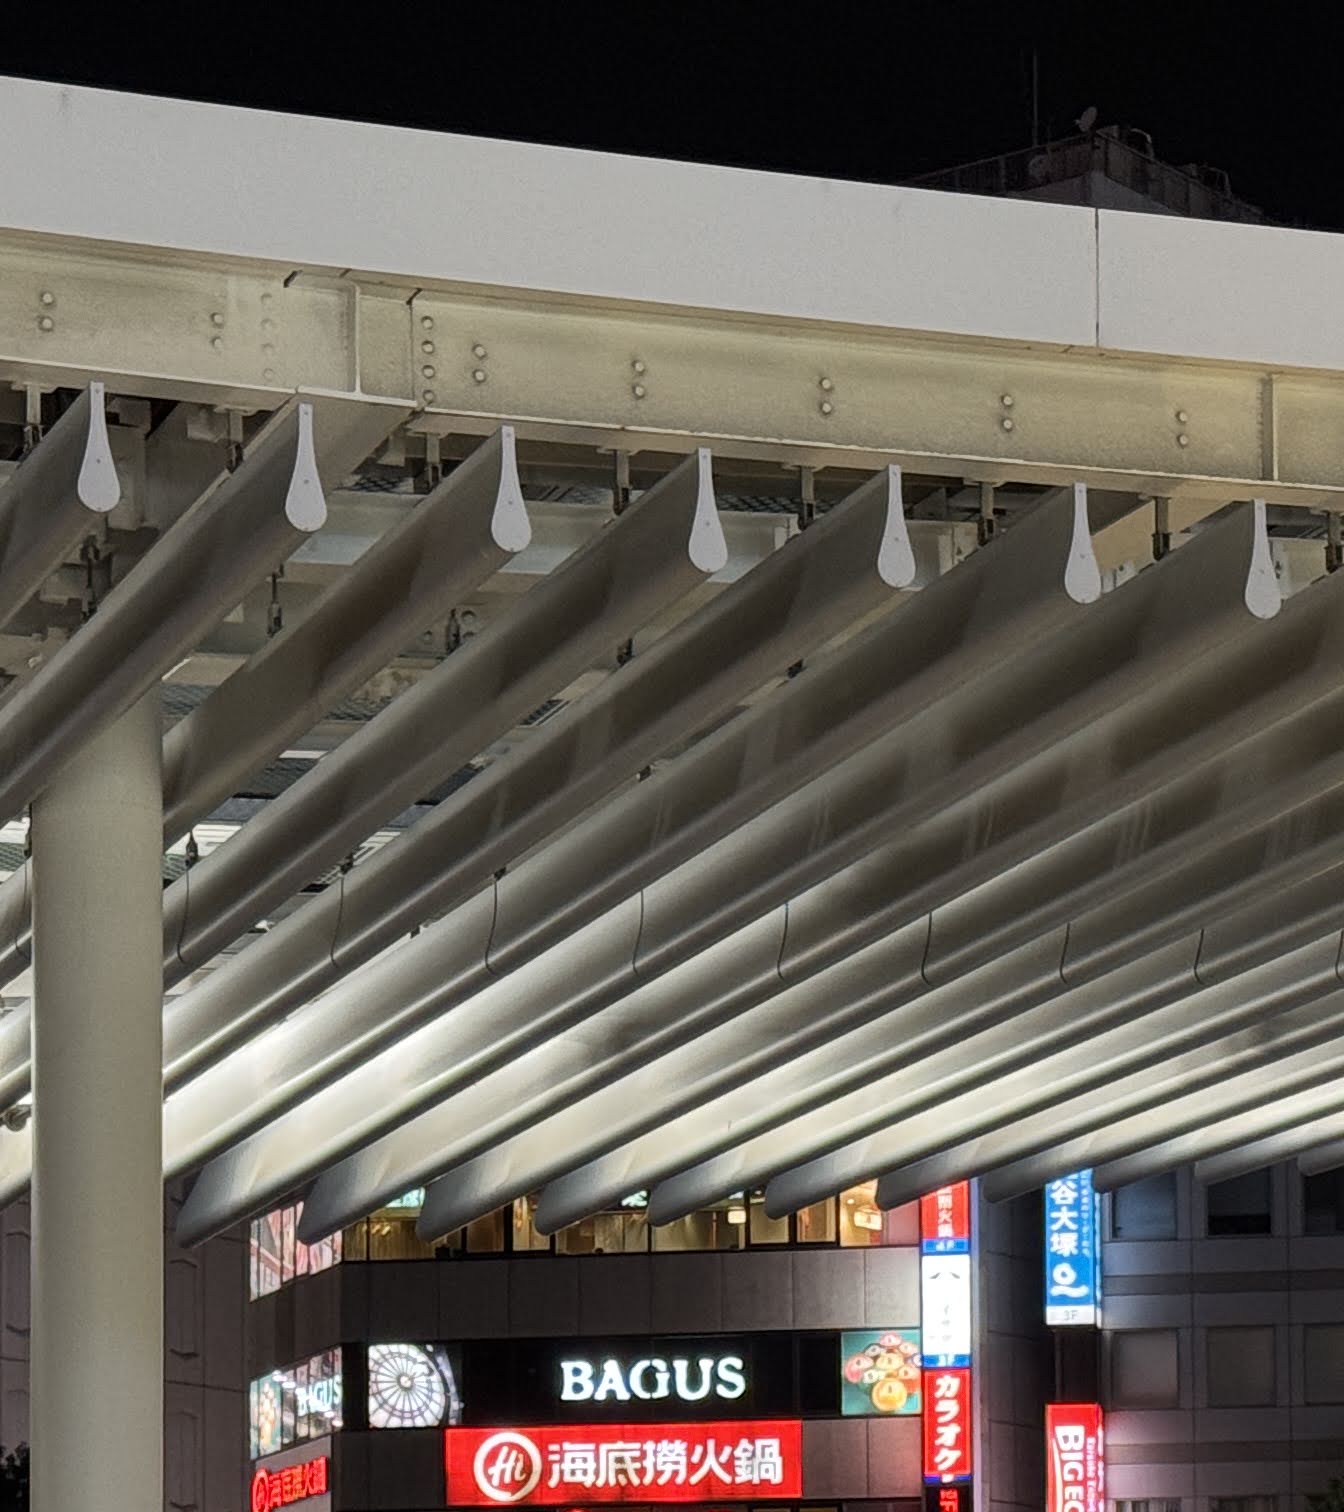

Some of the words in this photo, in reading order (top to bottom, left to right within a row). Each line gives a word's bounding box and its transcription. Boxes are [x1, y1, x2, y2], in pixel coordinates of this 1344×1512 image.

[1050, 1175, 1078, 1257] 谷大塚
[560, 1356, 746, 1401] BAGUS
[934, 1375, 961, 1471] カラオケ
[547, 1438, 783, 1488] 海底撈火鍋
[1055, 1425, 1086, 1481] BIG
